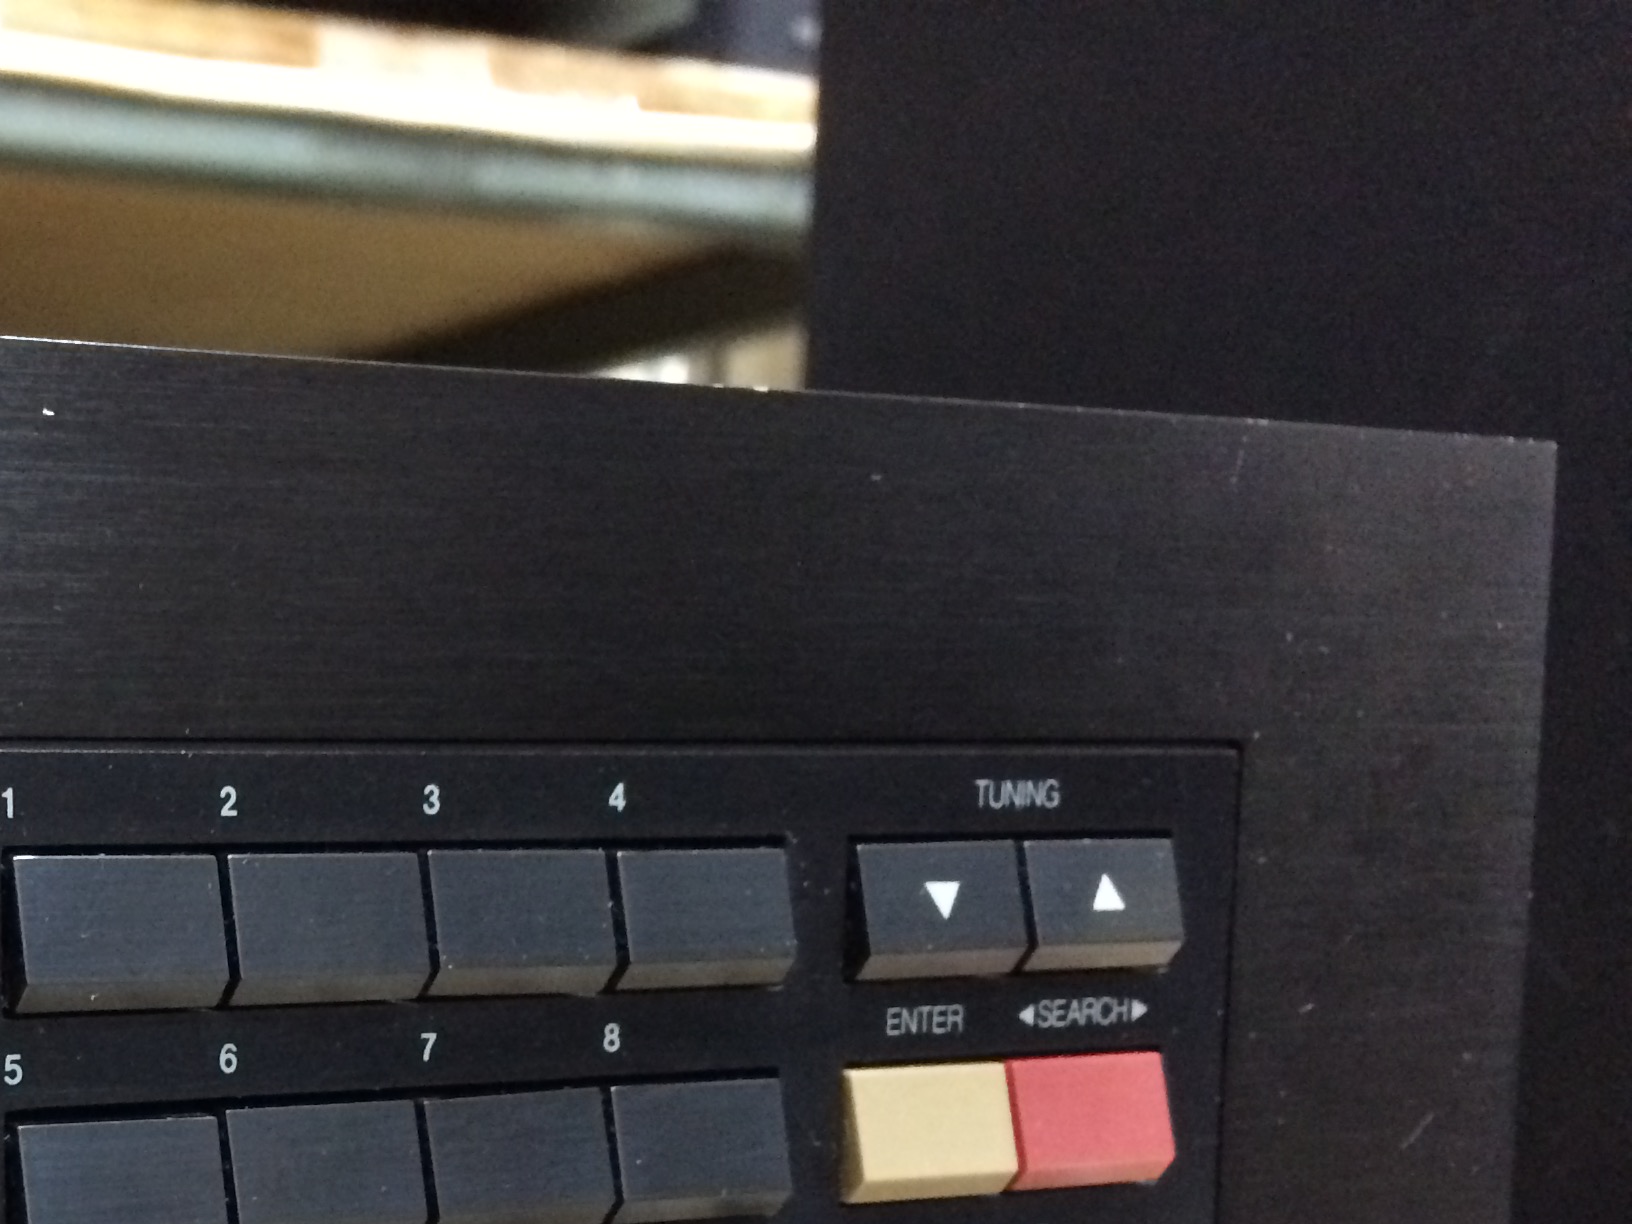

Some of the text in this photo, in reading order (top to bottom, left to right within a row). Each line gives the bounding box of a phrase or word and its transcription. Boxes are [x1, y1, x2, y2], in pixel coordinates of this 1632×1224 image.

[0, 786, 16, 819] 1
[219, 785, 238, 817] 2
[422, 783, 441, 815] 3
[608, 782, 627, 812] 4
[975, 778, 1060, 810] TUNING
[885, 1004, 964, 1036] ENTER
[1037, 996, 1129, 1029] SEARCH
[420, 1032, 437, 1062] 7
[602, 1022, 621, 1053] 8
[3, 1053, 23, 1086] 5
[219, 1043, 238, 1074] 6
